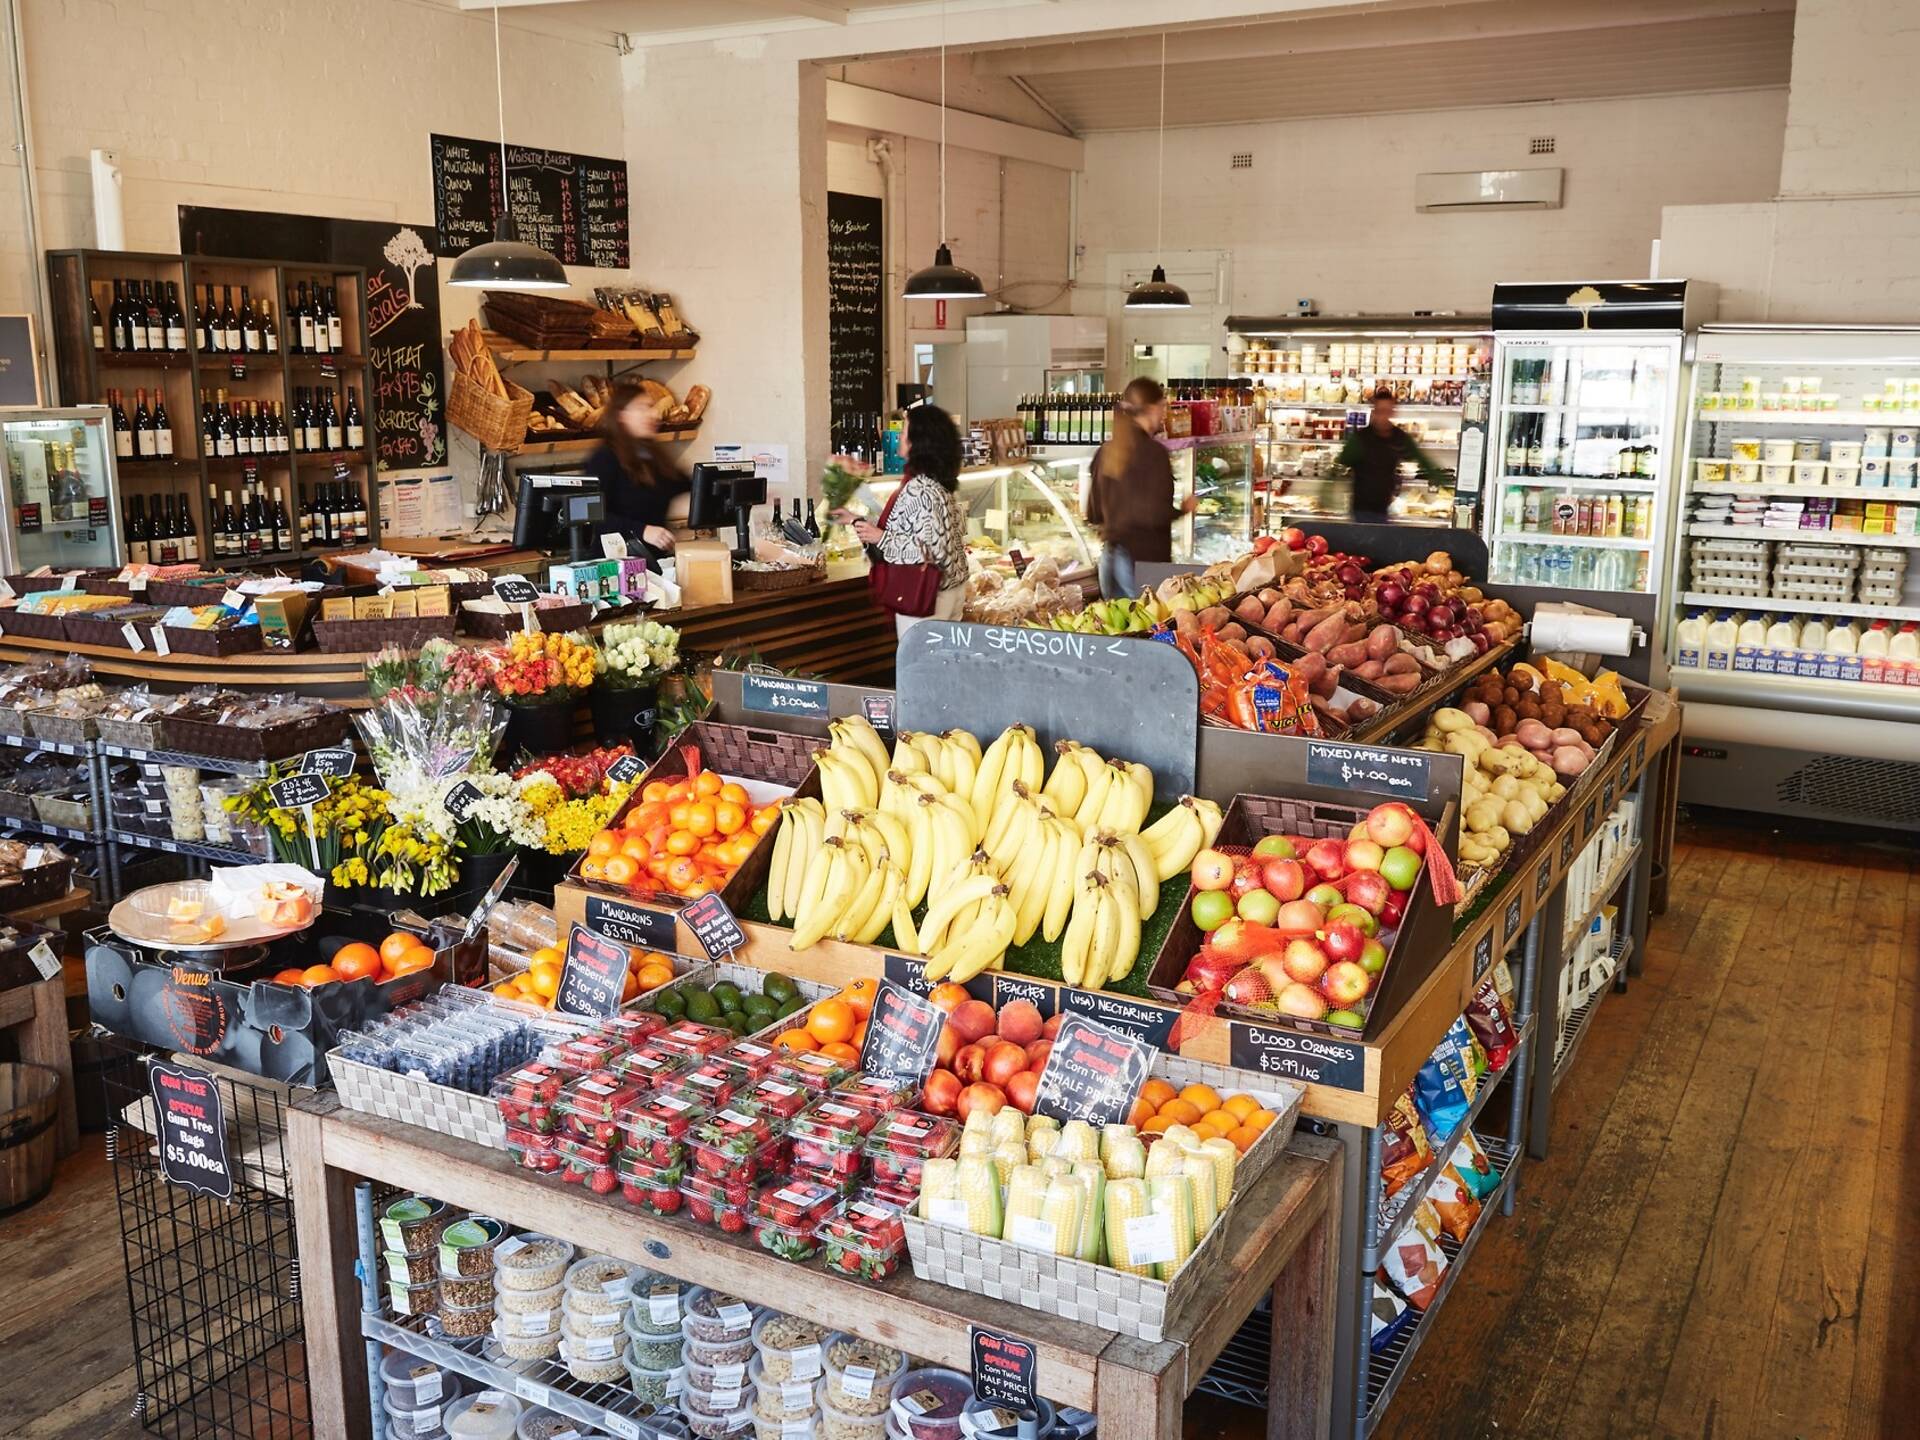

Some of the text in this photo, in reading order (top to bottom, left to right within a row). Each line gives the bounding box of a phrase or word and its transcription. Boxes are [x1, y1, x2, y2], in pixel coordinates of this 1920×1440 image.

[951, 626, 973, 648] IN
[750, 676, 794, 692] MANDARIN
[1311, 745, 1422, 767] MIXED APPLE NETS
[1341, 762, 1388, 782] $4.00
[601, 901, 653, 926] MANDARINS
[710, 929, 722, 940] for
[172, 967, 210, 986] Venus
[568, 955, 616, 990] Blueberries
[569, 974, 607, 1003] 2 for $9
[997, 979, 1046, 1000] PEACHES
[565, 990, 602, 1021] $5.99ea
[1098, 999, 1164, 1024] NECTARINES
[874, 1019, 922, 1054] Strawberries
[1249, 1028, 1355, 1061] BLOOD ORANGES
[871, 1037, 913, 1070] 2 for $6
[1054, 1072, 1084, 1093] HALF
[1065, 1059, 1120, 1090] Corn Twins
[1051, 1093, 1106, 1126] $1.75ea
[167, 1110, 214, 1135] Gum Tree
[180, 1130, 205, 1149] Bags
[166, 1144, 225, 1175] $5.00ea
[980, 1372, 1028, 1394] HALF PRICE
[984, 1364, 1022, 1382] Corn Twins
[984, 1385, 1027, 1405] $1.75ea
